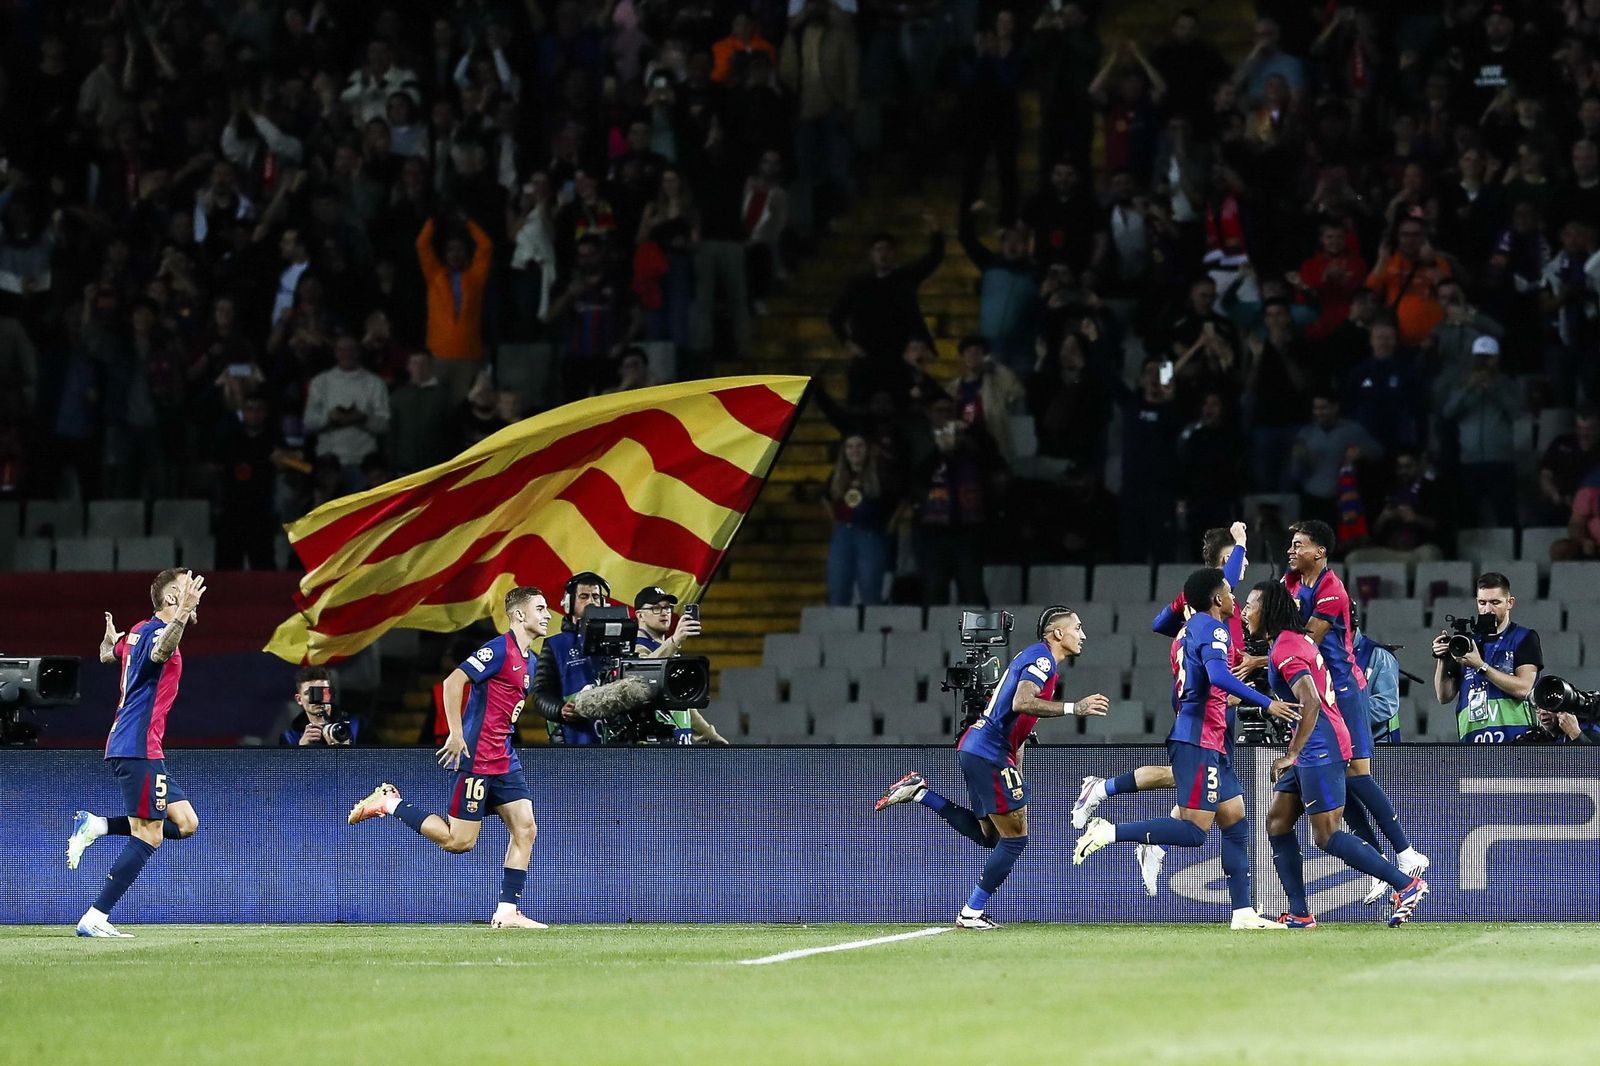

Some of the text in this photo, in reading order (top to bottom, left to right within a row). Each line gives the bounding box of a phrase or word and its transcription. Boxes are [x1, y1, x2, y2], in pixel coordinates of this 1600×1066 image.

[155, 774, 167, 798] 5
[464, 777, 485, 801] 16
[1206, 766, 1218, 790] 3
